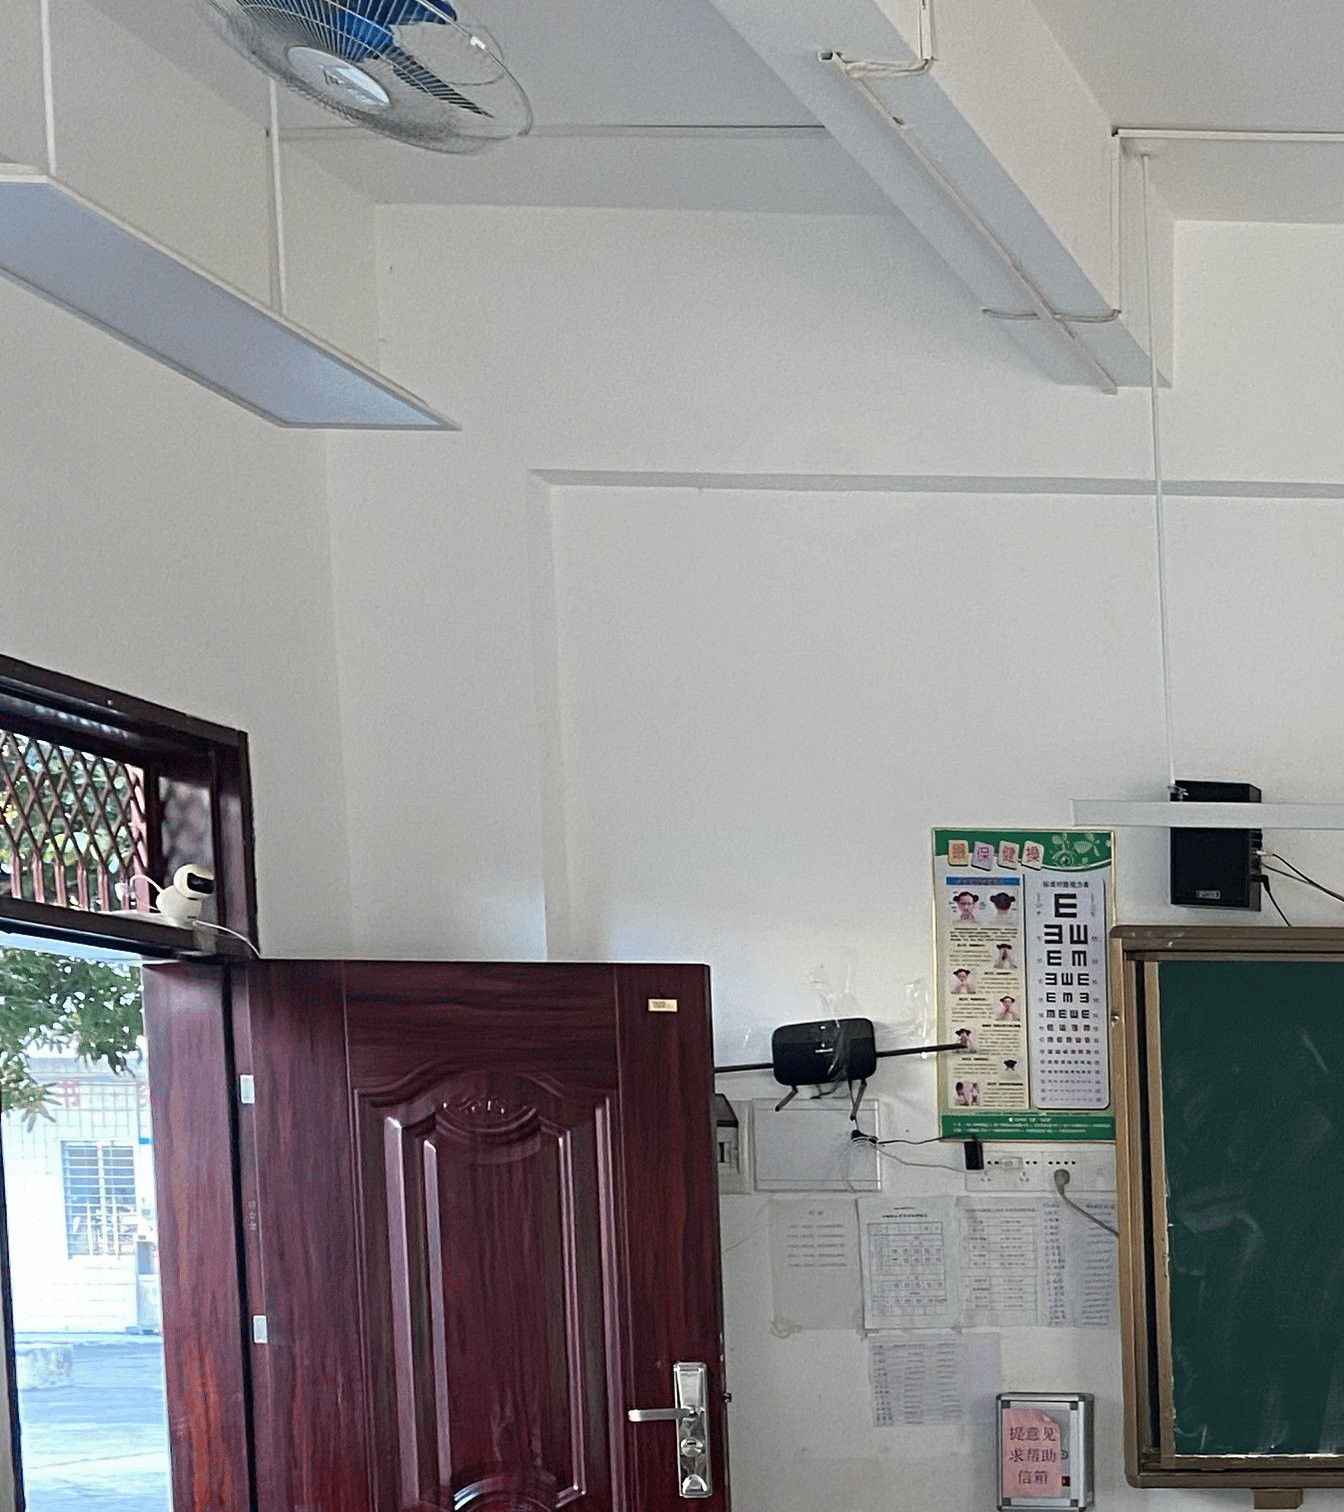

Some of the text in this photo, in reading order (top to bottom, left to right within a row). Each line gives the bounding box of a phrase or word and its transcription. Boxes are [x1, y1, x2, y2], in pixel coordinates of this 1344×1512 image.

[1009, 1426, 1056, 1441] 提意见
[1009, 1448, 1057, 1462] 求帮助
[1018, 1470, 1048, 1485] 信箱
